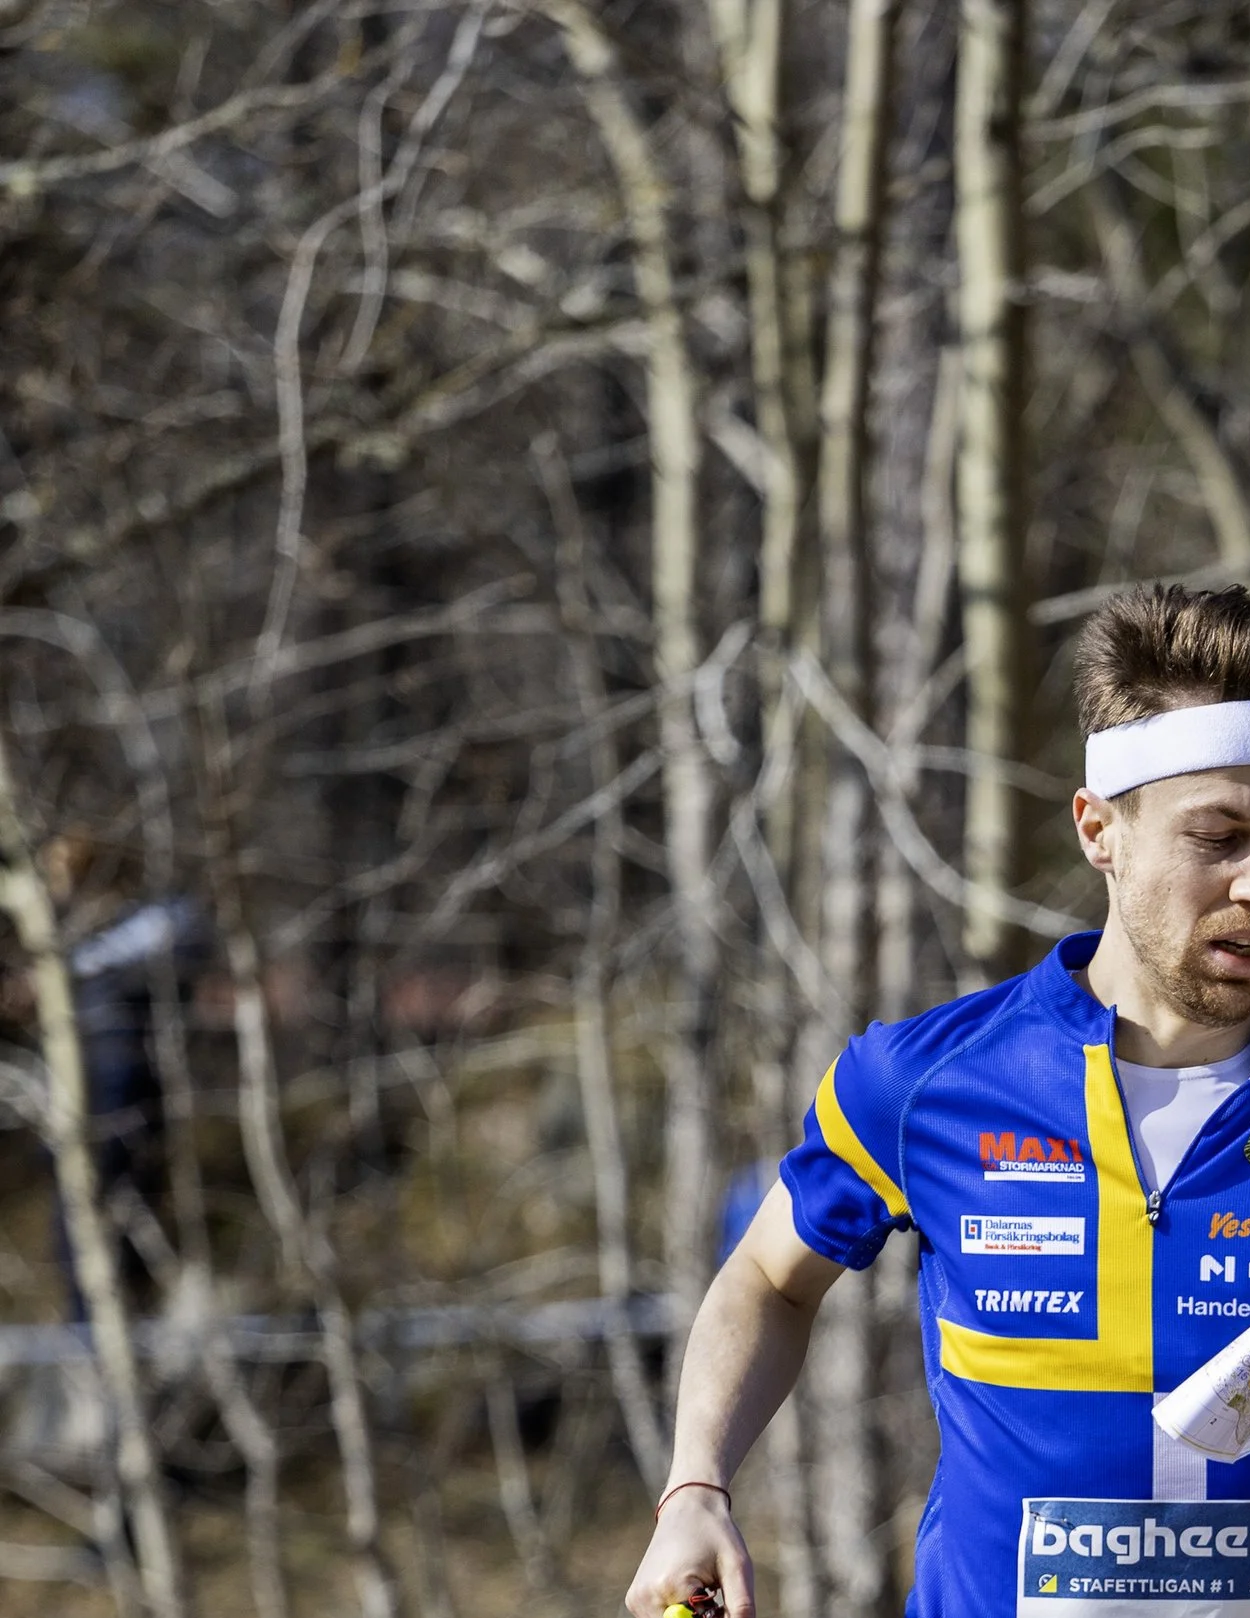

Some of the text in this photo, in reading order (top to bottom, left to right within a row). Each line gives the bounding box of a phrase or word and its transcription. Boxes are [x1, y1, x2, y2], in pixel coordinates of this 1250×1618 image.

[979, 1132, 1083, 1162] MAXI
[999, 1161, 1084, 1172] STORMARKNAD
[985, 1219, 1033, 1230] Dalarnas
[985, 1231, 1080, 1244] Försäkringsbolag
[974, 1289, 1085, 1313] TRIMTEX
[1069, 1577, 1205, 1593] STAFETTLIGAN
